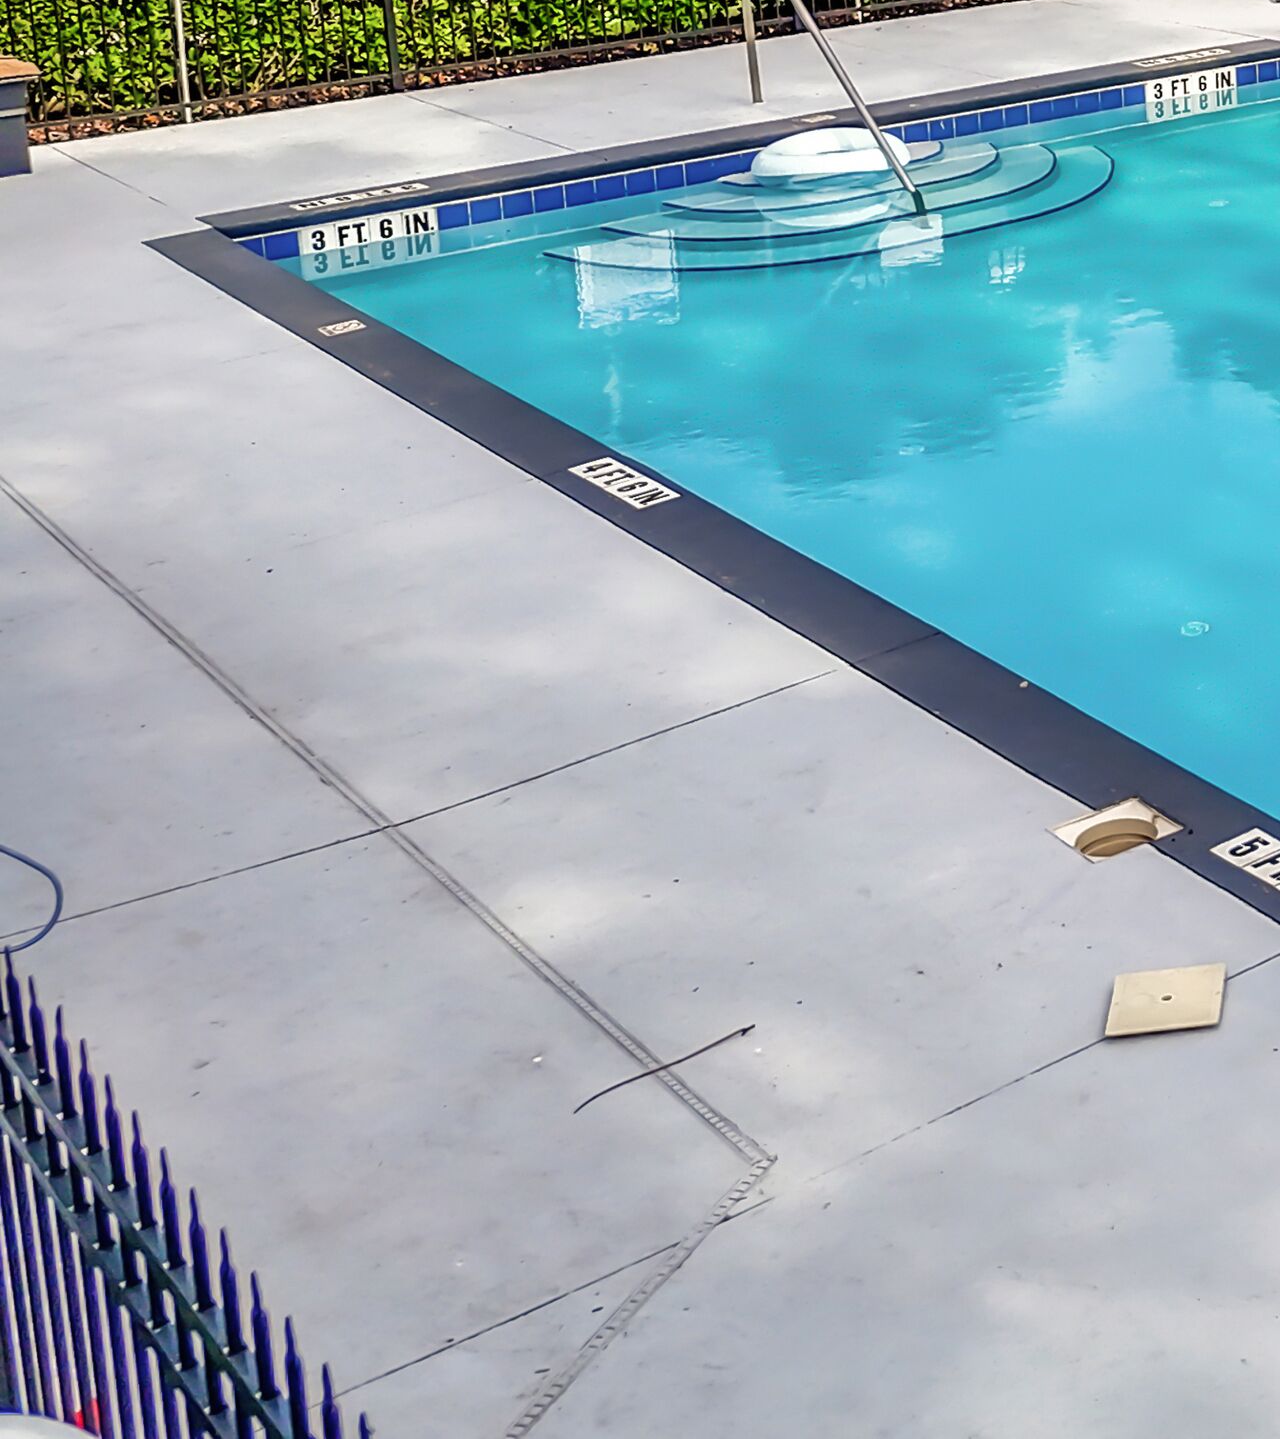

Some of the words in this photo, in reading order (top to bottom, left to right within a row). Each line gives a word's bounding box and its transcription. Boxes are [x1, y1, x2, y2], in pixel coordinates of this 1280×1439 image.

[1154, 83, 1163, 99] 3
[1199, 75, 1207, 91] 6
[311, 230, 325, 251] 3
[337, 222, 368, 247] FT.
[379, 219, 393, 239] 6
[405, 211, 435, 235] IN.
[1228, 836, 1271, 857] 5
